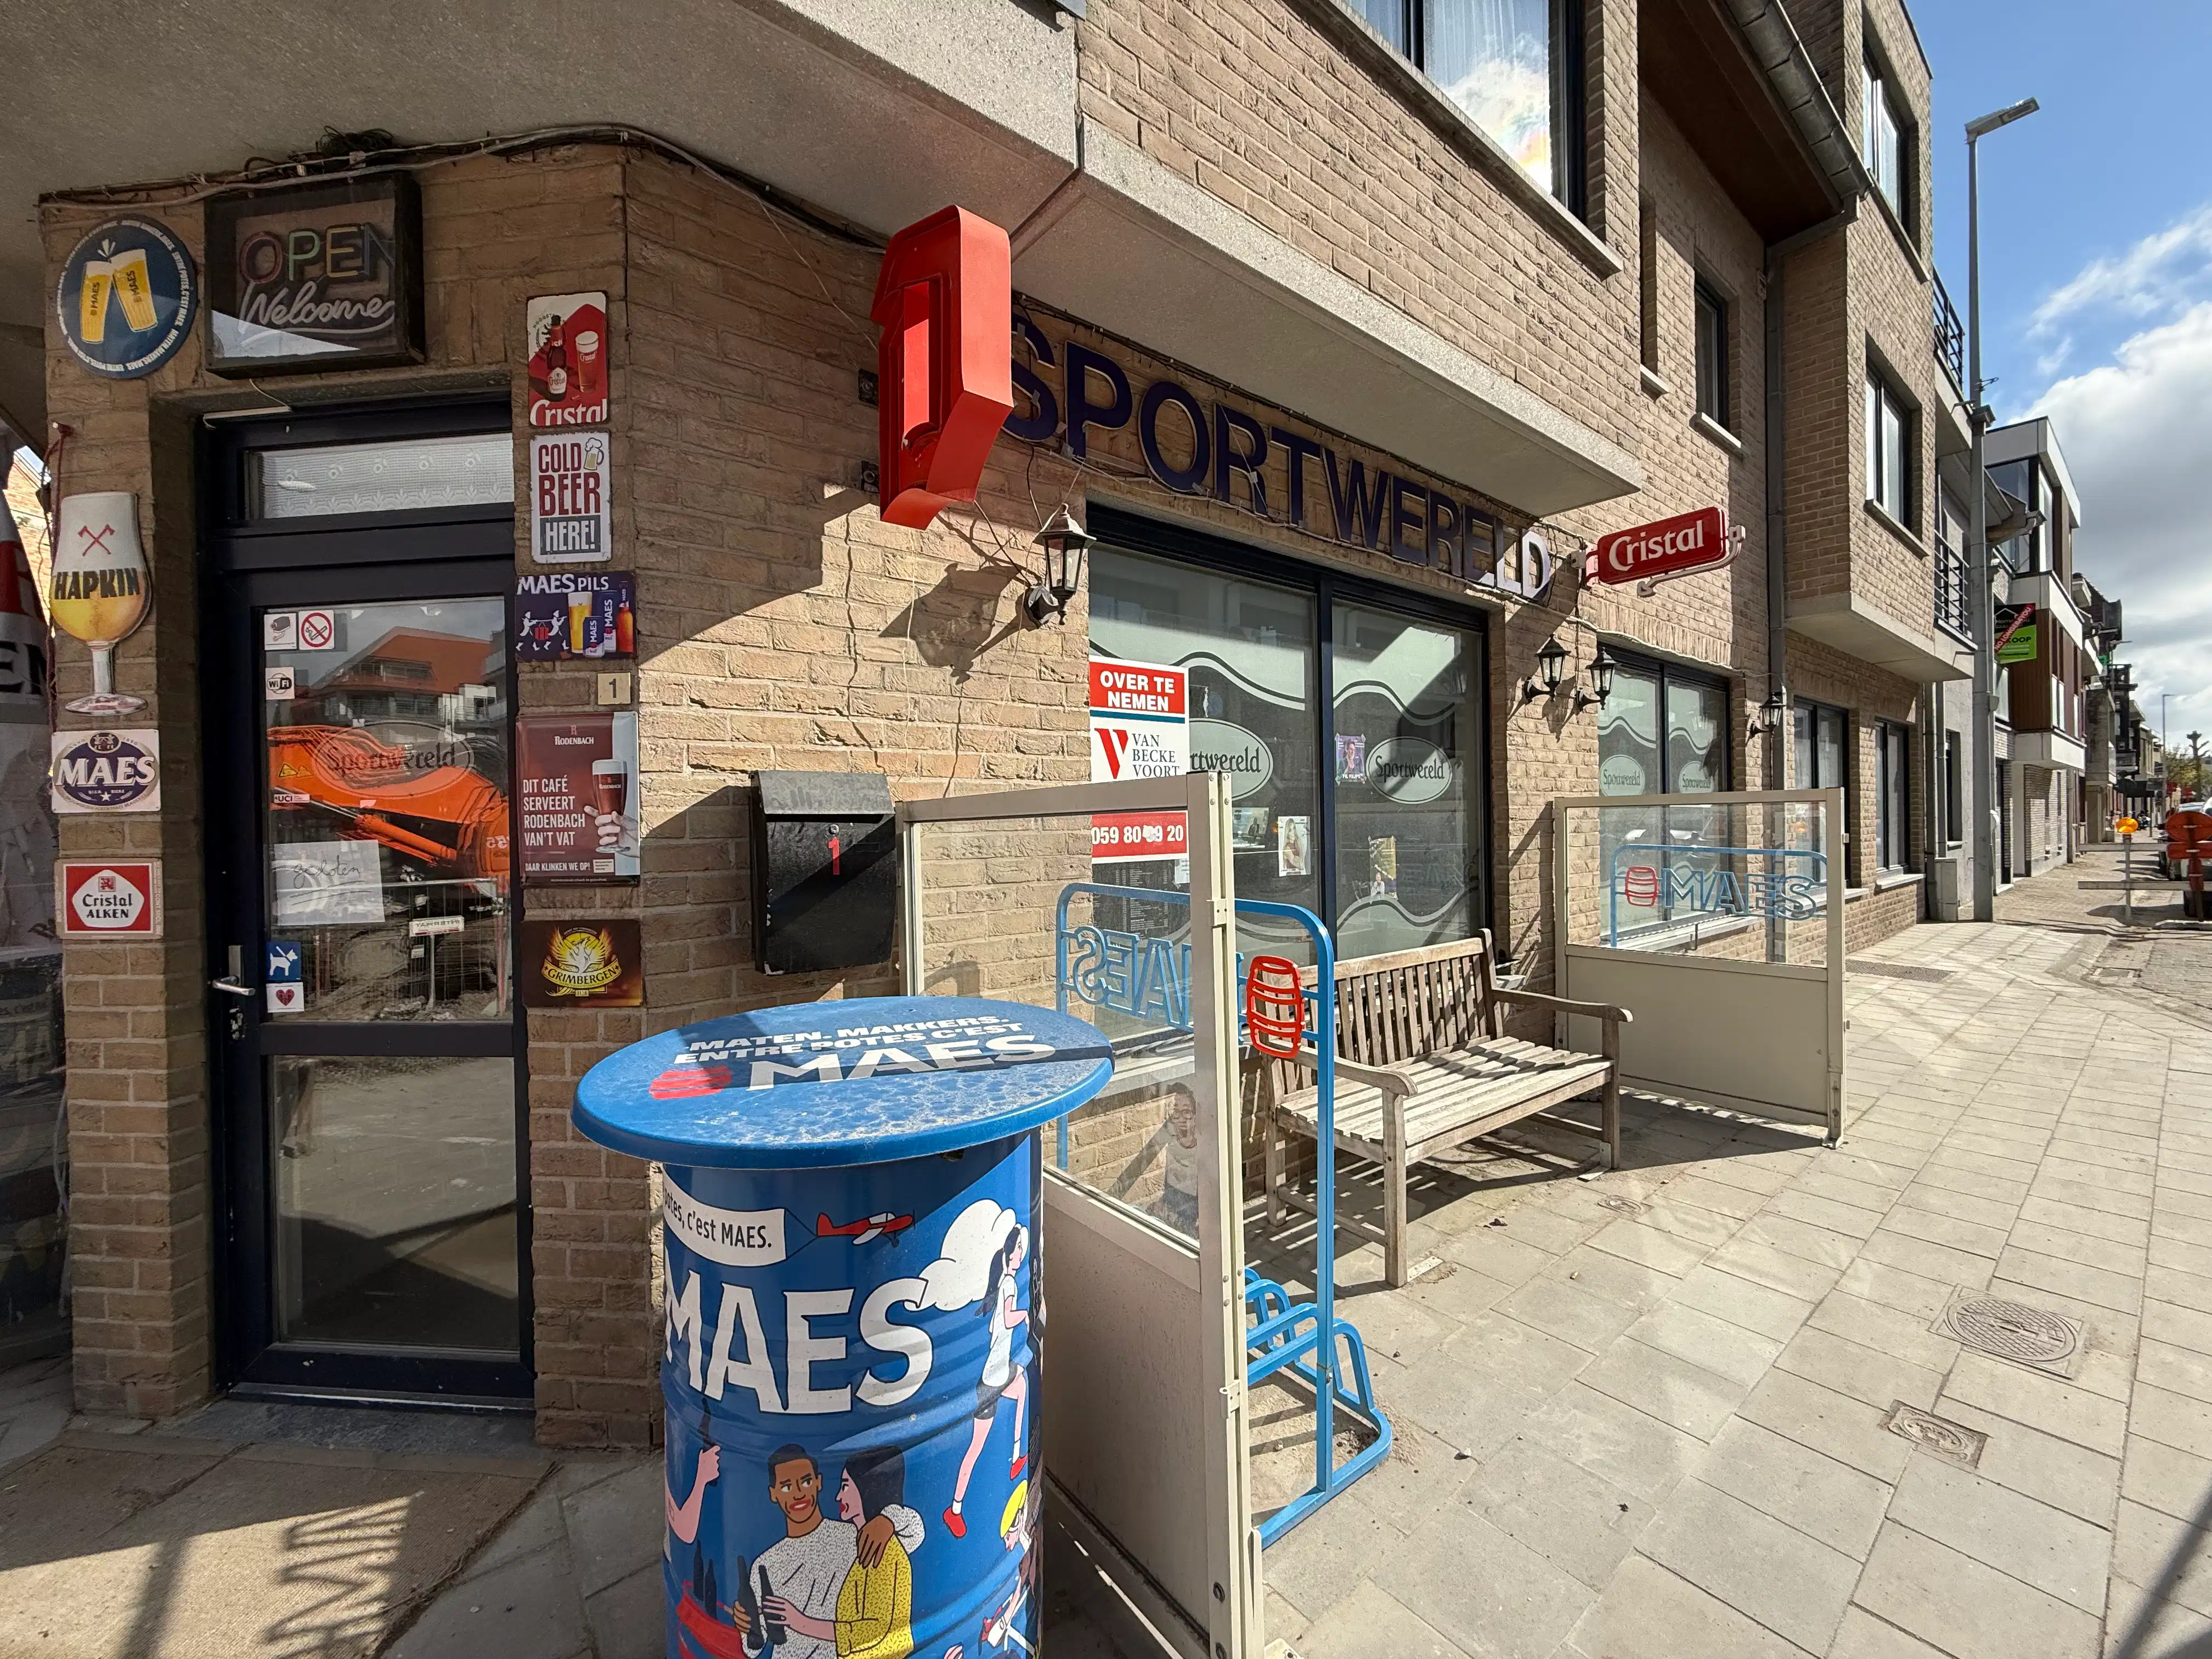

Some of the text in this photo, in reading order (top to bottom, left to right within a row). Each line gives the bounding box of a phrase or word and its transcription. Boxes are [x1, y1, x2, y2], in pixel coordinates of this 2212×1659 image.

[240, 223, 395, 284] OPEN
[90, 282, 100, 308] MAES
[127, 270, 140, 297] MAES
[238, 281, 395, 334] Welcome
[580, 351, 596, 362] Cristal
[530, 398, 607, 426] Cristal
[538, 443, 582, 473] COLD
[1002, 312, 1550, 599] SPORTWERELD
[539, 472, 600, 516] BEER
[545, 520, 595, 551] HERE!
[1608, 520, 1705, 572] Cristal
[54, 567, 140, 600] HAPKIN
[516, 574, 609, 595] MAES PILS
[605, 599, 613, 627] MAES
[608, 678, 618, 699] 1
[1100, 671, 1175, 694] OVER TE
[1108, 691, 1169, 712] NEMEN
[554, 736, 594, 746] RODENBACH
[1132, 733, 1160, 747] VAN
[1132, 749, 1176, 763] BECKE
[1189, 746, 1262, 773] rtwereld
[1375, 755, 1445, 783] Sportwereld
[55, 756, 155, 787] MAES
[523, 774, 568, 793] DIT CAFÉ
[1132, 764, 1180, 778] VOORT
[1603, 768, 1641, 789] Sportwereld
[523, 795, 575, 811] SERVEERT
[524, 813, 585, 829] RODENBACH
[524, 832, 575, 846] VAN'T VAT
[1090, 825, 1184, 845] 059 80 9 20
[525, 862, 540, 871] DAAR
[541, 862, 567, 871] KLINKEN
[568, 862, 578, 871] WE
[579, 862, 590, 871] OP!
[828, 838, 840, 876] 1
[82, 893, 133, 907] Cristal
[1662, 867, 1817, 921] MAES
[86, 909, 129, 918] ALKEN
[548, 967, 617, 985] GRIMBERGEN
[674, 1023, 1024, 1065] ENTRE POTES C'EST
[689, 1015, 1010, 1051] MATEN. MAKKERS.
[746, 1035, 1057, 1092] MAES
[687, 1210, 716, 1242] c'est
[721, 1222, 772, 1249] MAES.
[665, 1246, 933, 1414] MAES
